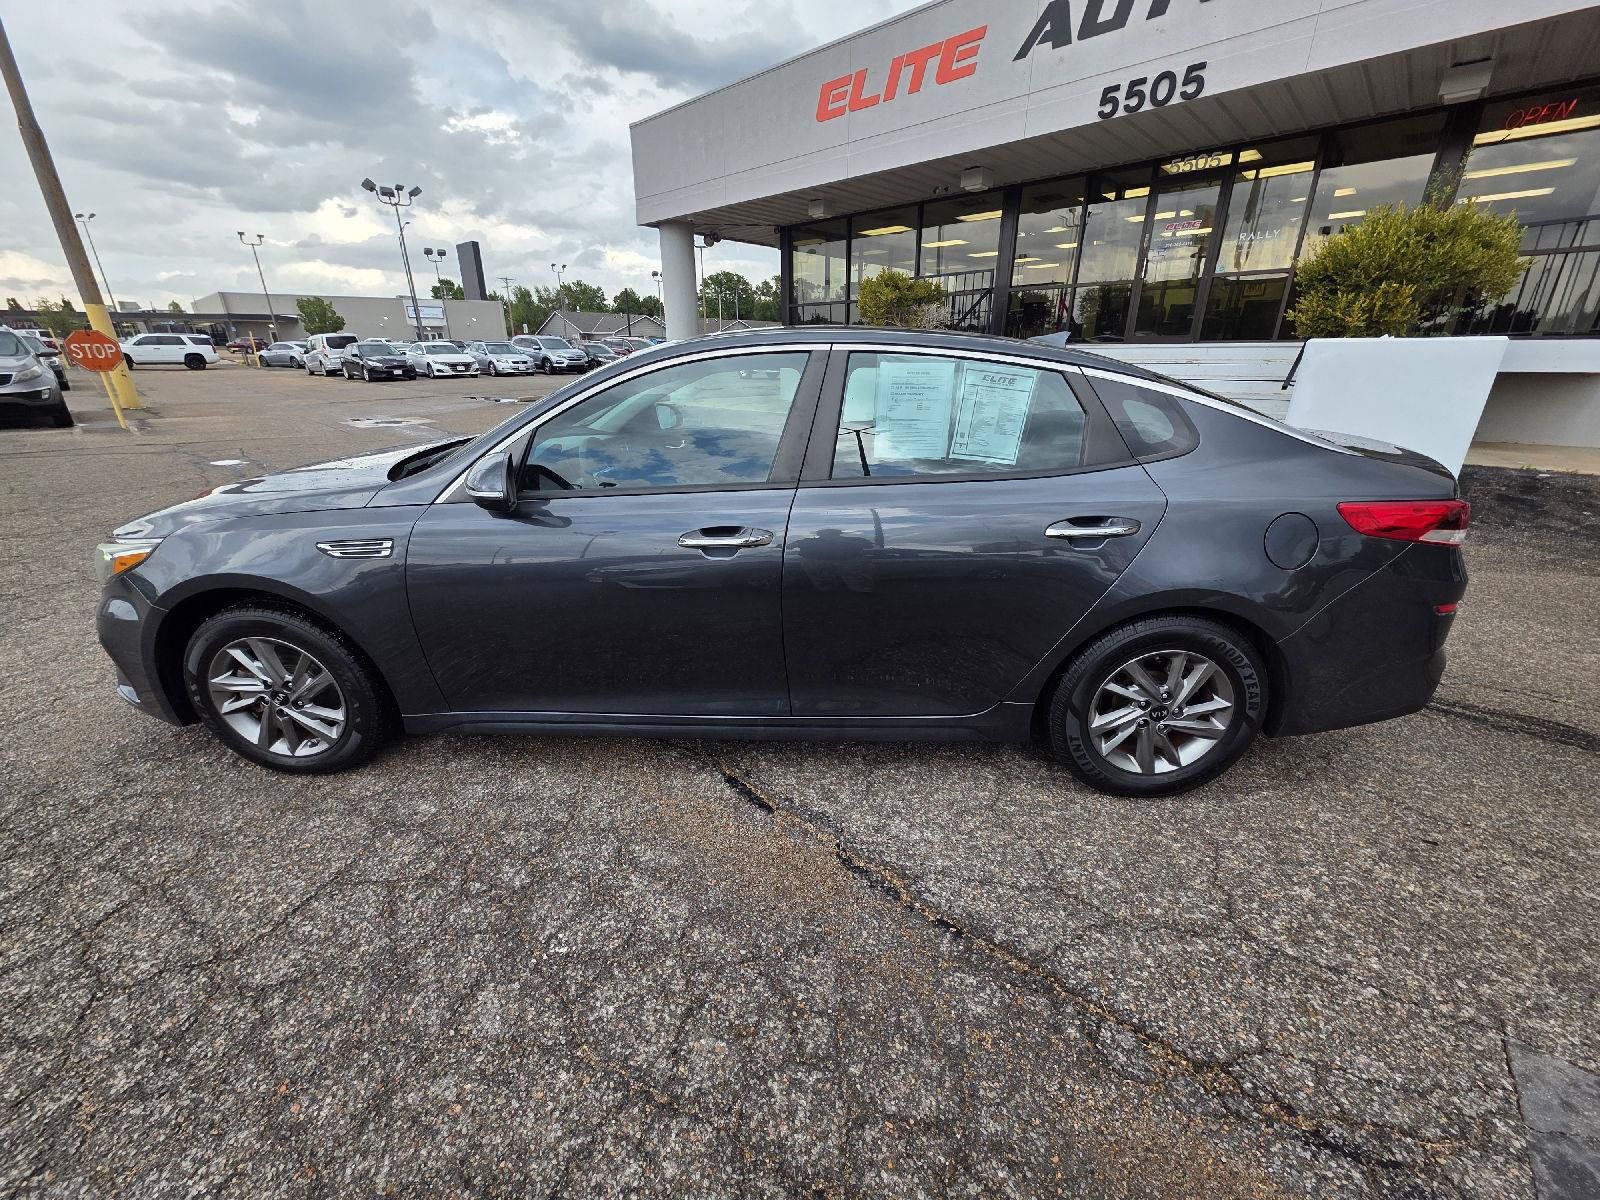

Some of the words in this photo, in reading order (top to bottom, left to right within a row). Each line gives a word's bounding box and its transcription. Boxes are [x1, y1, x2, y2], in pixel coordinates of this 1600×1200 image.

[1012, 0, 1170, 62] AU
[816, 25, 988, 123] ELITE
[1098, 61, 1208, 120] 5505
[1505, 98, 1578, 129] OPEN
[1169, 152, 1222, 174] 5505
[1240, 229, 1280, 241] RALLY
[70, 343, 116, 359] STOP
[982, 374, 1018, 385] ELITE
[1151, 709, 1168, 719] KIA
